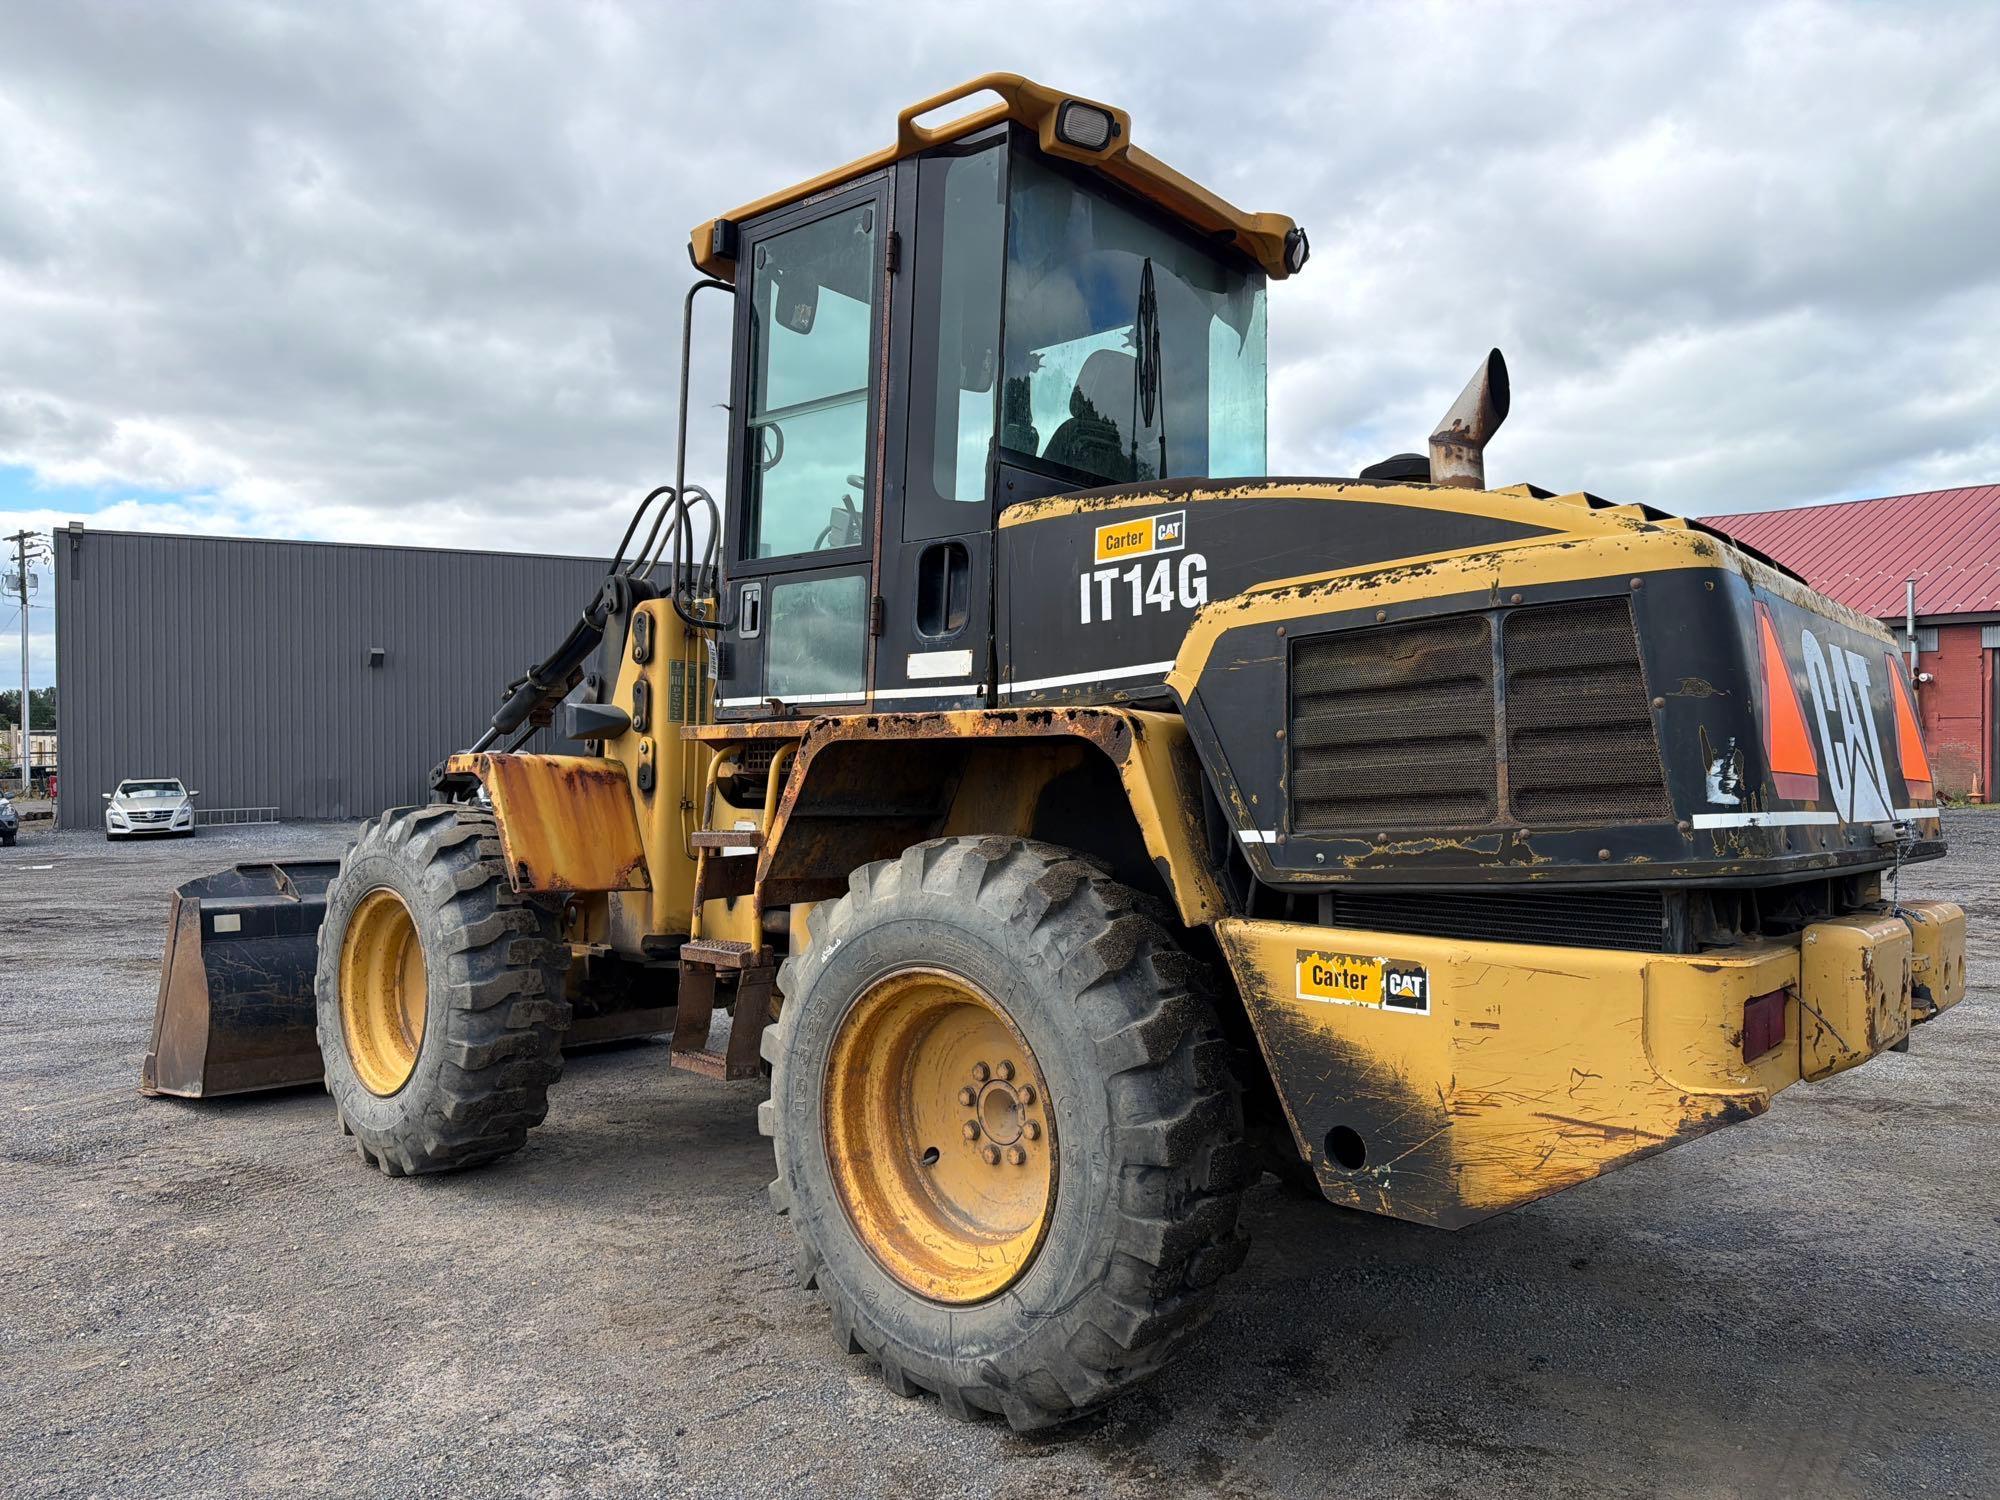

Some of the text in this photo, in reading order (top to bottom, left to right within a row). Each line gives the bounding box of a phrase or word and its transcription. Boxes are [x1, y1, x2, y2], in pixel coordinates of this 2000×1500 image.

[1106, 521, 1182, 550] Carter CAT
[1080, 553, 1208, 624] IT14G
[1801, 629, 1896, 824] CAT
[1312, 965, 1423, 998] Carter CAT
